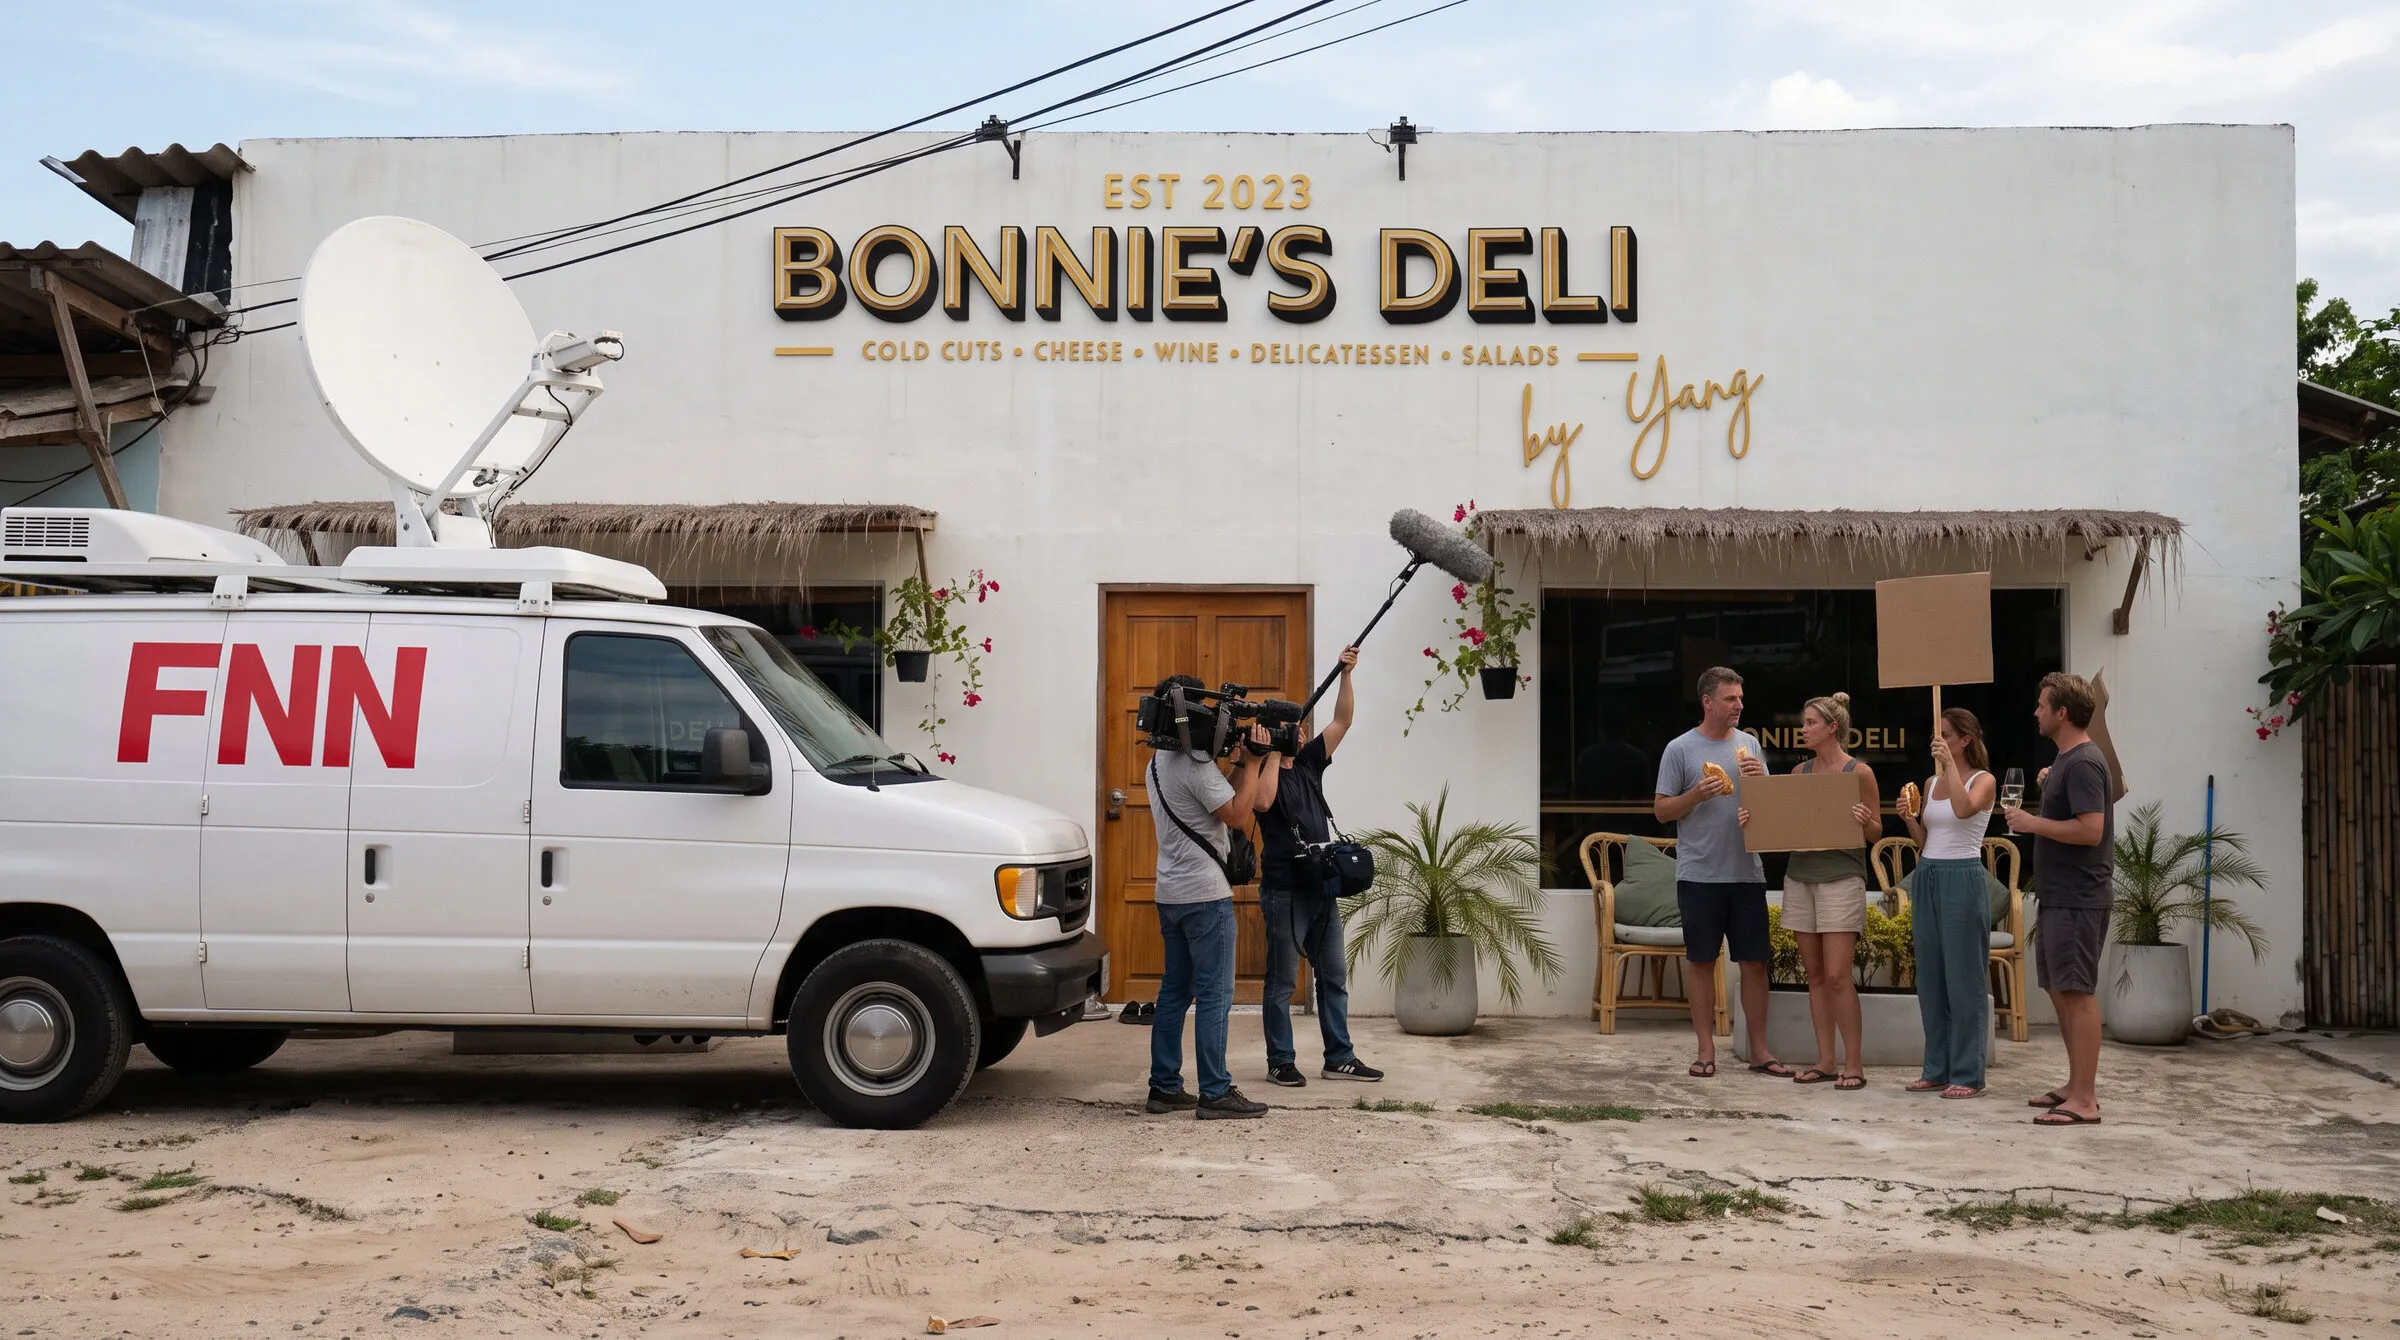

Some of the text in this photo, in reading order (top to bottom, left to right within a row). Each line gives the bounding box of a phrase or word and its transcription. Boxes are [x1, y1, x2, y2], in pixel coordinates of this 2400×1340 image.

[1104, 173, 1312, 210] EST 2023
[773, 224, 1638, 326] BONNIE'S DELI
[862, 339, 1559, 366] COLD CUTS CHEESE WINE DELICATESSEN SALADS
[1521, 354, 1764, 511] by Yang
[117, 642, 428, 769] FNN
[1847, 727, 1906, 749] DELI
